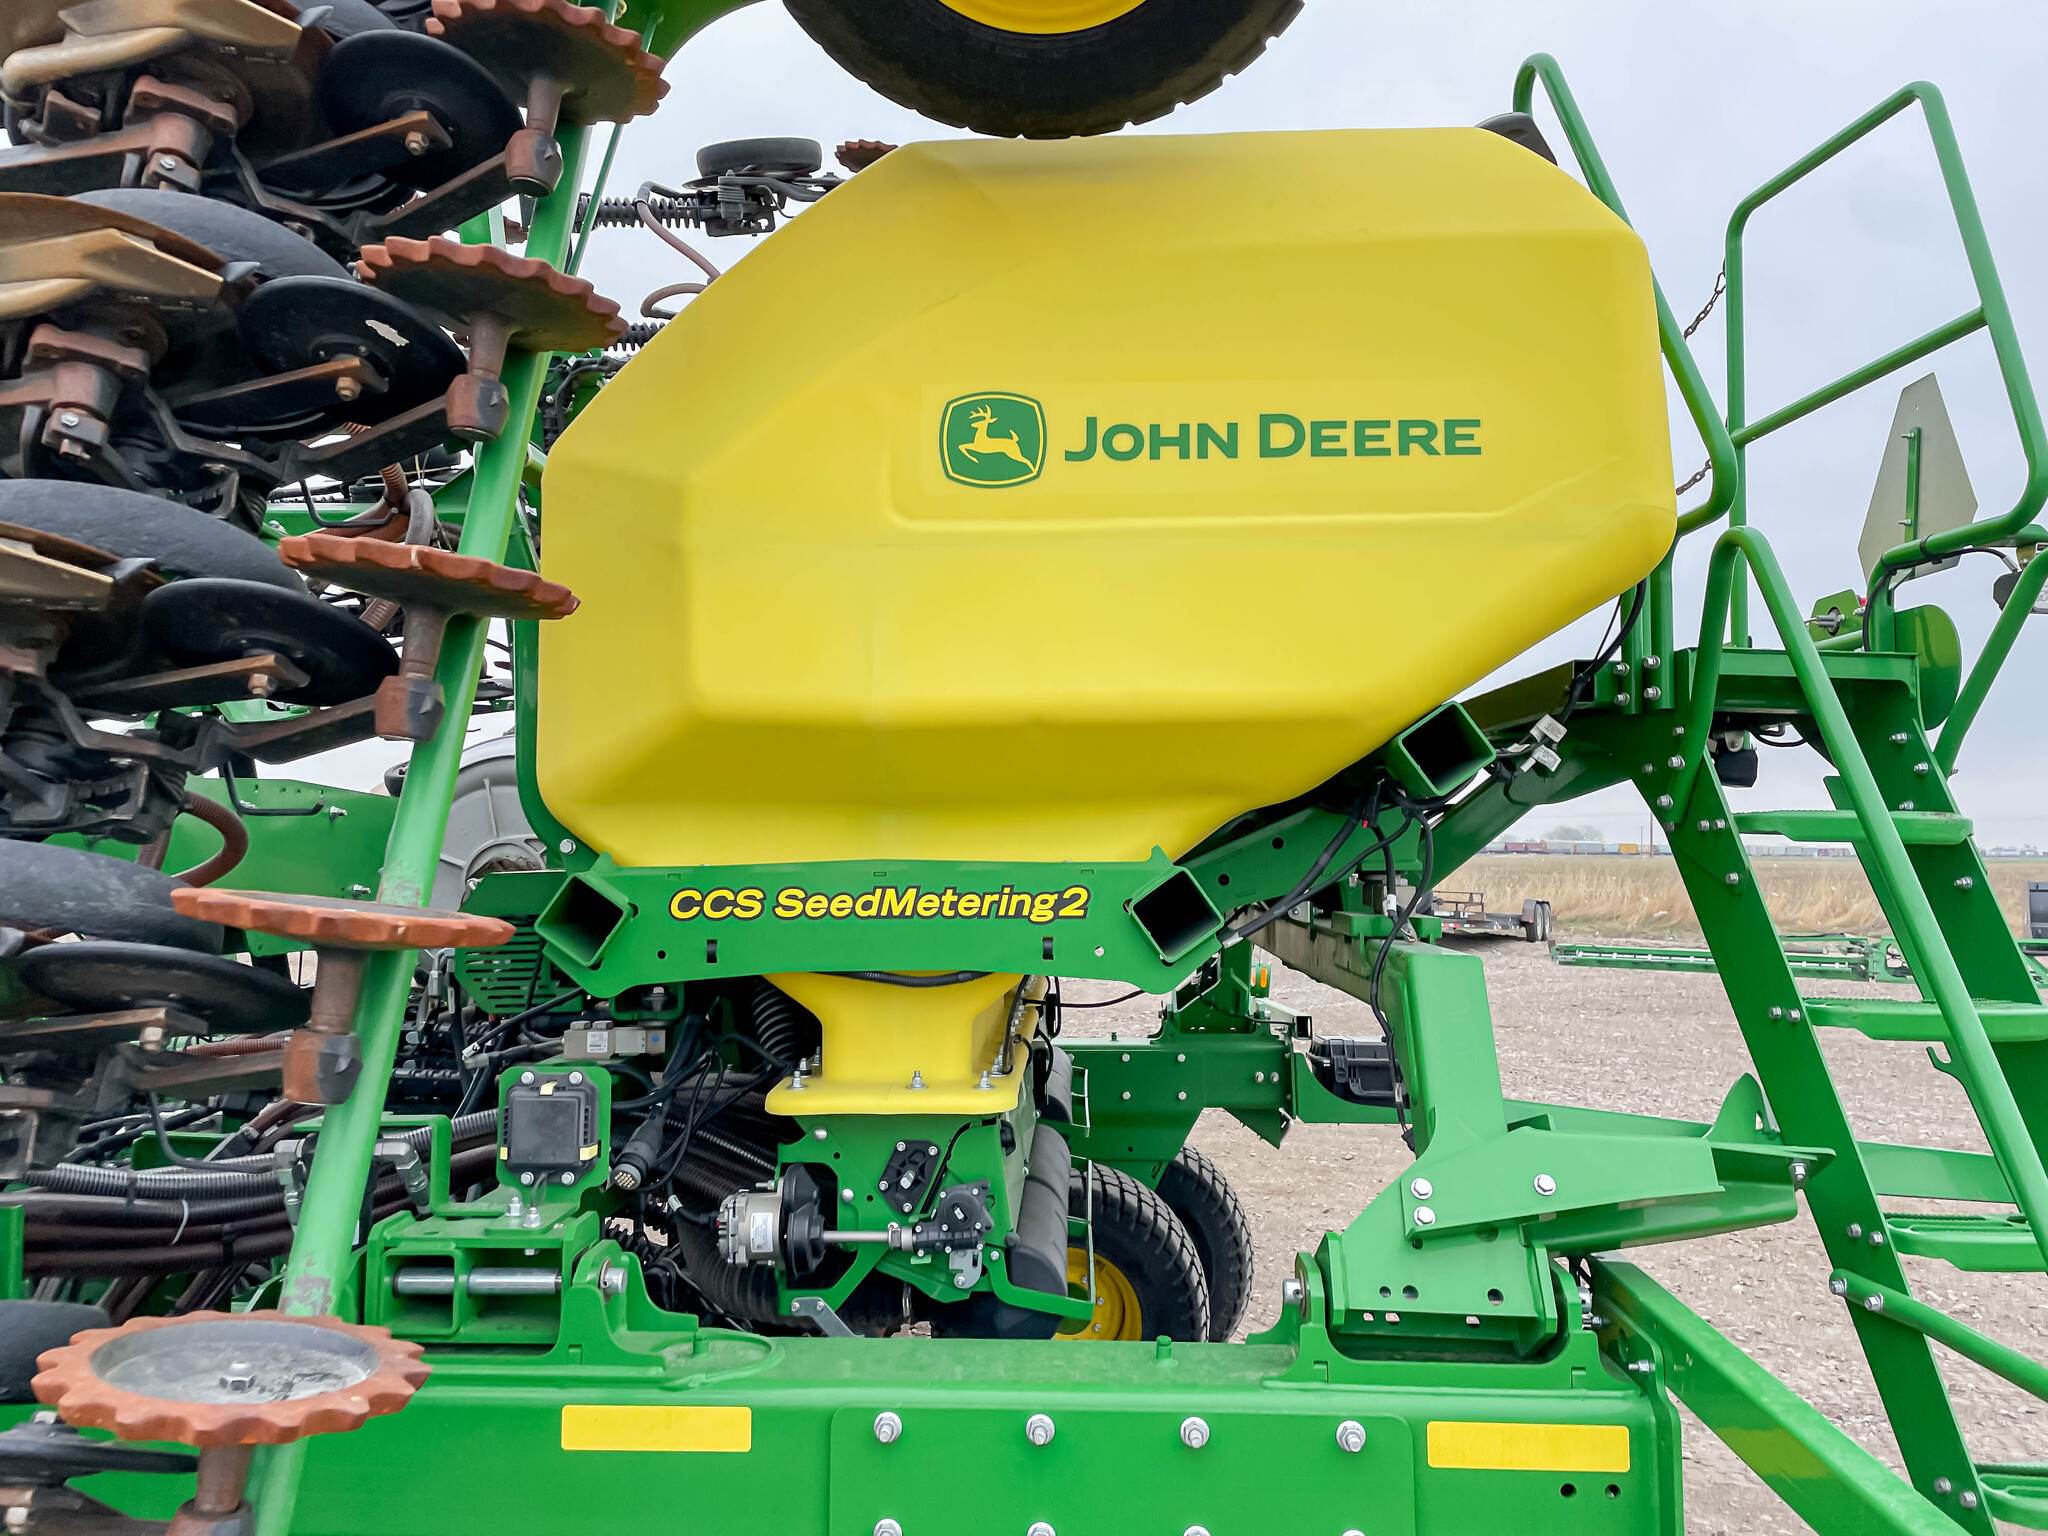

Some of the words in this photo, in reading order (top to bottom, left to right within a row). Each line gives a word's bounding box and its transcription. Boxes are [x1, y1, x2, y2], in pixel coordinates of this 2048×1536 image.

[1064, 416, 1239, 462] JOHN
[1259, 413, 1482, 458] DEERE
[669, 888, 764, 920] CCS
[773, 887, 1089, 923] SeedMetering2
